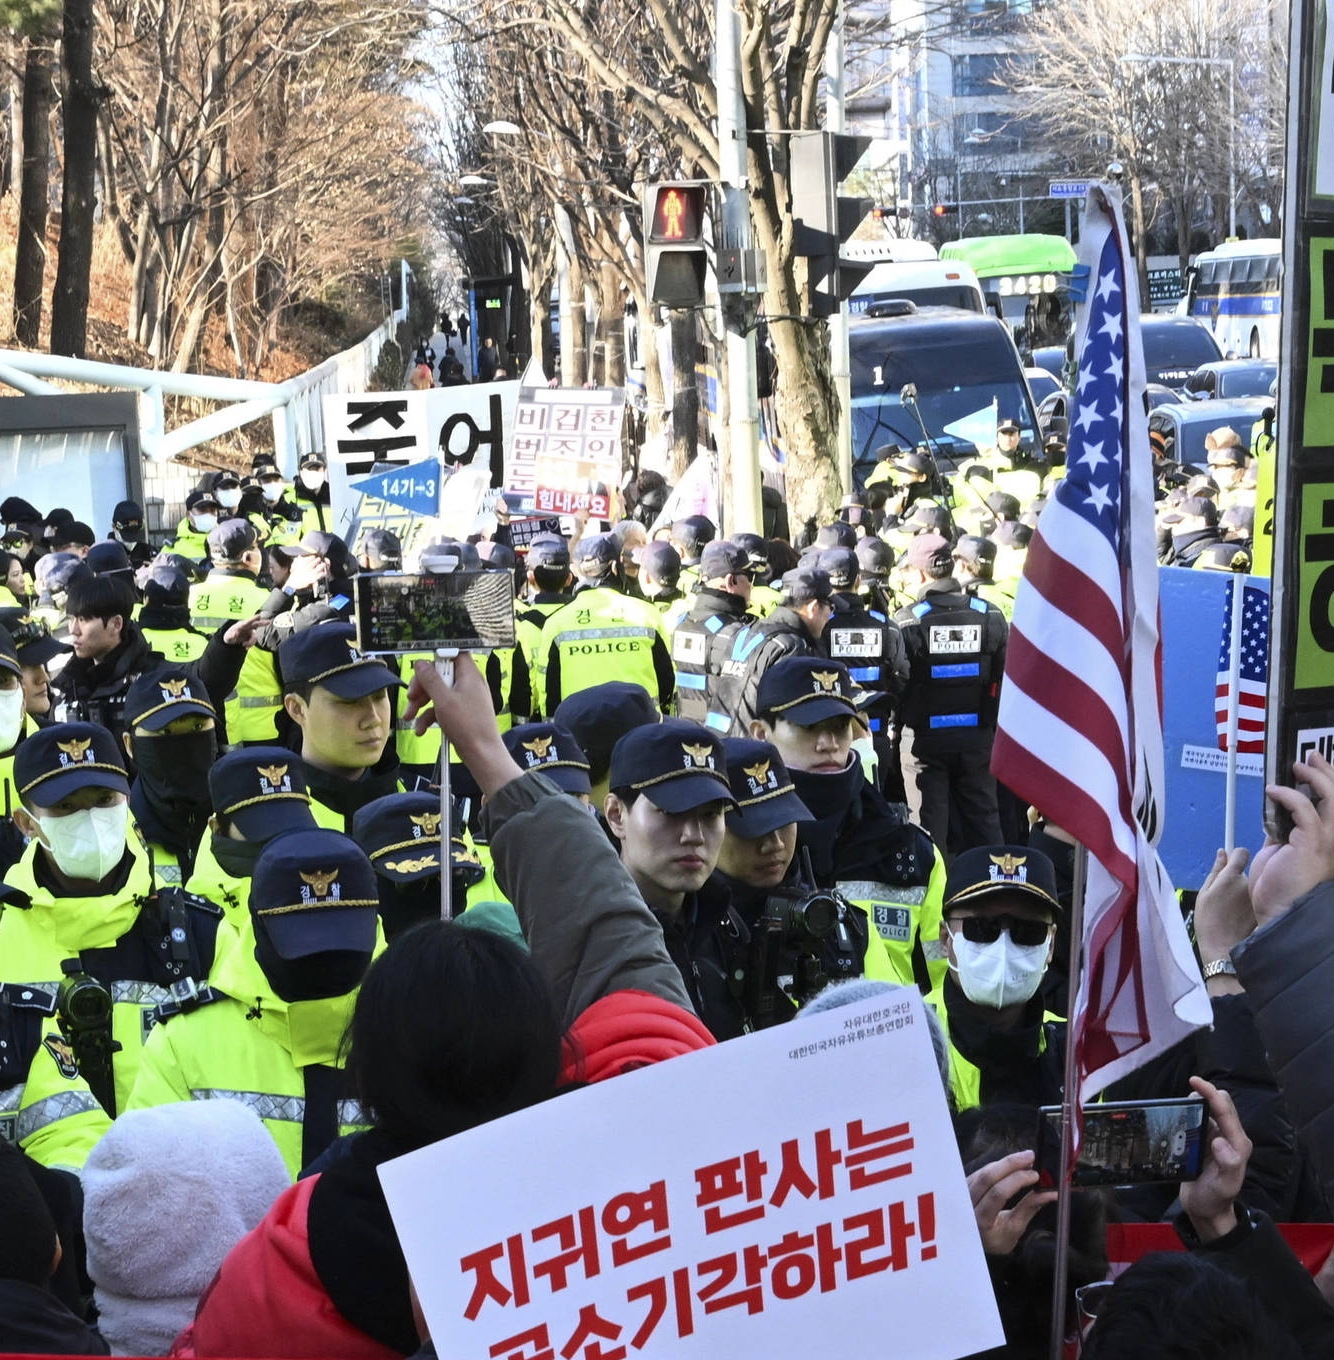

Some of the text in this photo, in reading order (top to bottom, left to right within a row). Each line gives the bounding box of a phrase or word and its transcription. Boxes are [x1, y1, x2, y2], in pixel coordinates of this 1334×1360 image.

[998, 273, 1057, 297] 3420
[381, 476, 436, 499] 14기-3
[569, 640, 641, 657] POLICE
[877, 907, 908, 925] 경찰
[843, 1001, 912, 1030] 자유대한호국단
[460, 1118, 915, 1322] 지귀연 판사는
